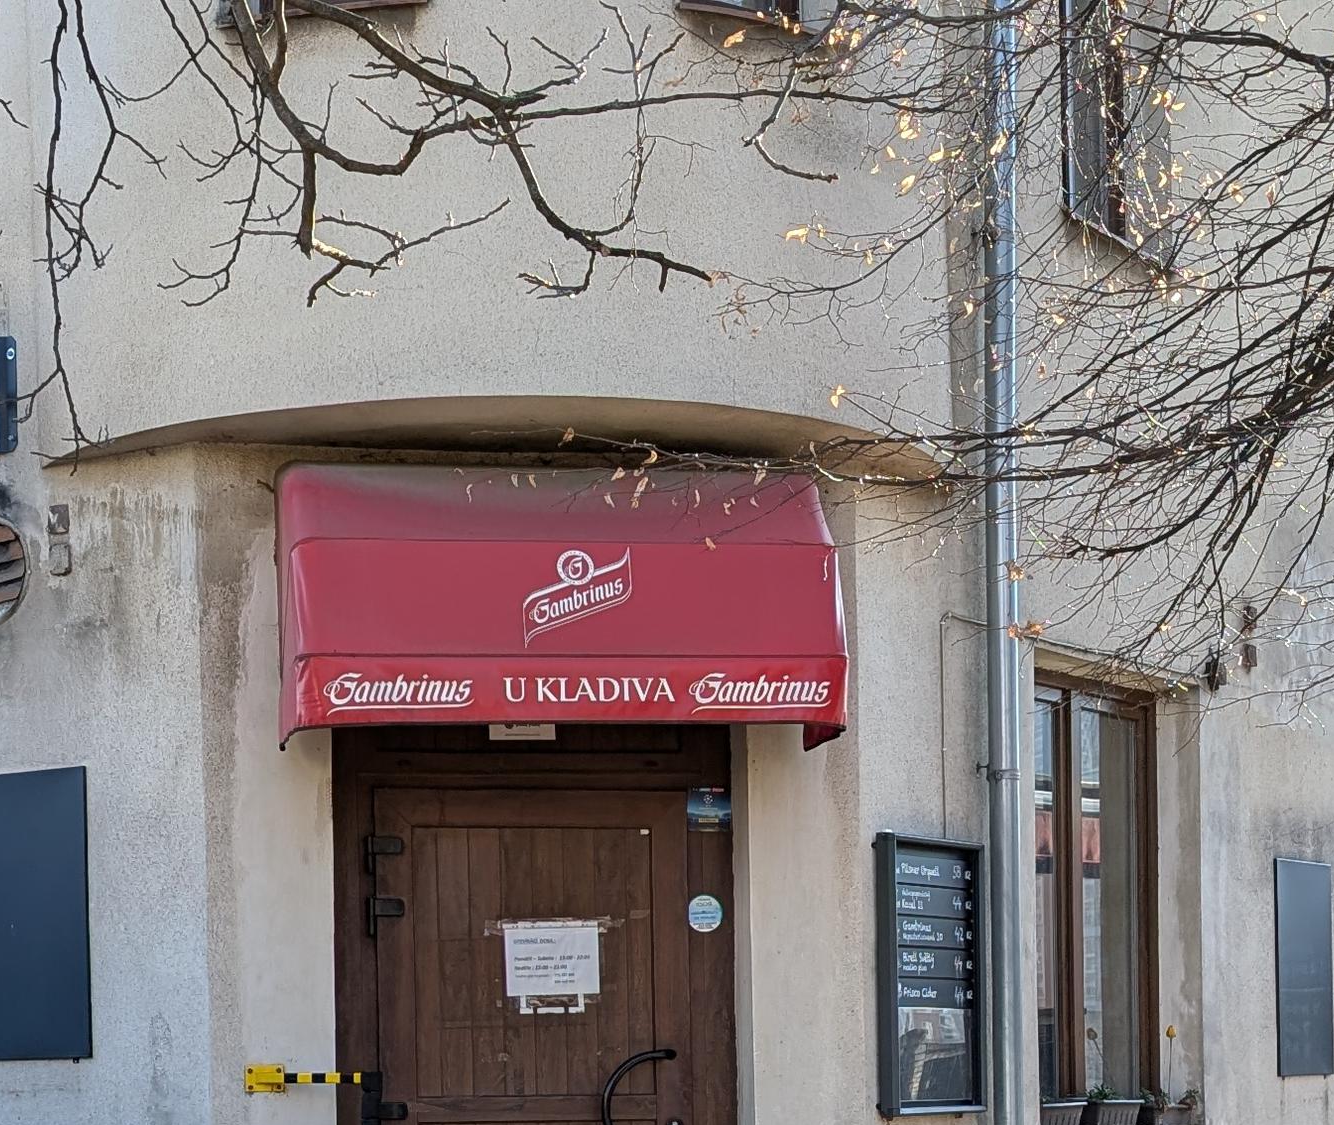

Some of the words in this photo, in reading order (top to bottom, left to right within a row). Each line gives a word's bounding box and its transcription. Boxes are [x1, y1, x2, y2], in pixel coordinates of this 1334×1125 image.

[529, 578, 623, 624] Gambrinus
[323, 672, 473, 705] Gambrinus
[503, 677, 526, 702] U
[535, 677, 676, 702] KLADIVA
[688, 673, 831, 704] Gambrinus
[953, 896, 962, 910] 44
[954, 926, 964, 941] 42
[903, 987, 920, 998] Frisco
